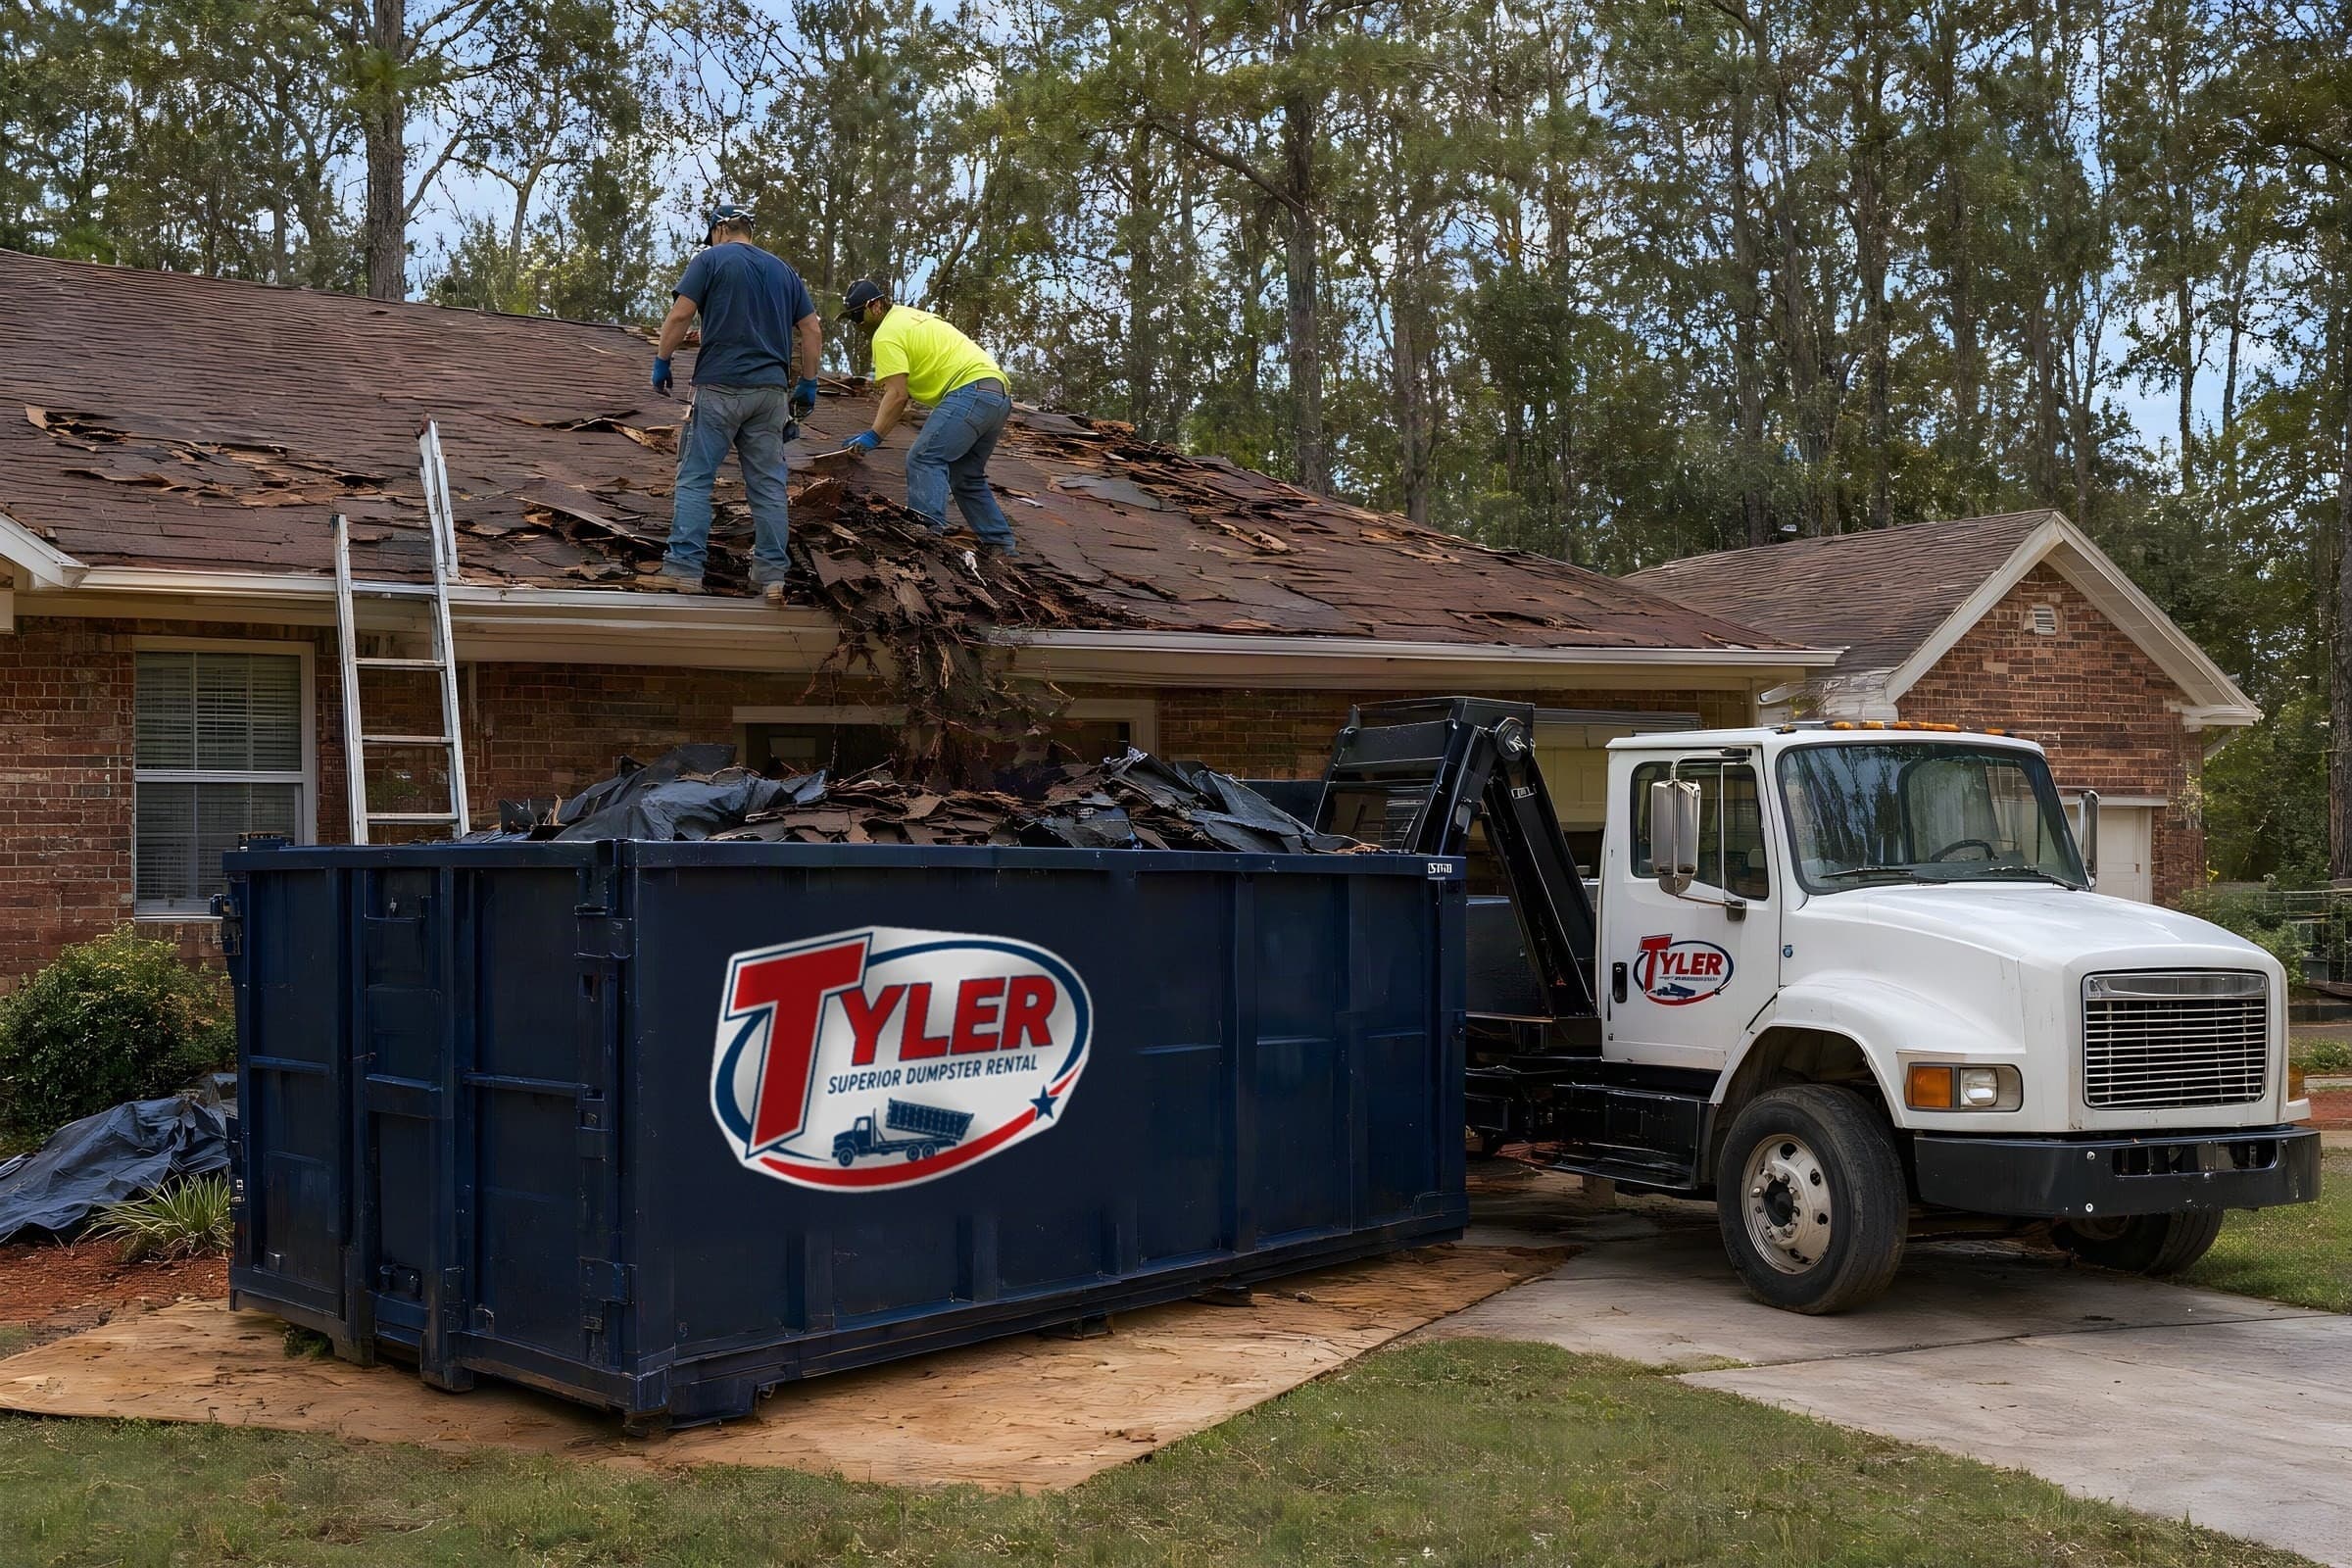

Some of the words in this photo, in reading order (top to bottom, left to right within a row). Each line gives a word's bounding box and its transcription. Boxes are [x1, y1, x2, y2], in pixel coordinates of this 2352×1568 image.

[1640, 935, 1723, 994] TYLER
[726, 935, 1057, 1154] TYLER
[827, 1069, 902, 1095] SUPERIOR
[906, 1060, 982, 1085] DUMPSTER
[986, 1054, 1038, 1076] RENTAL
